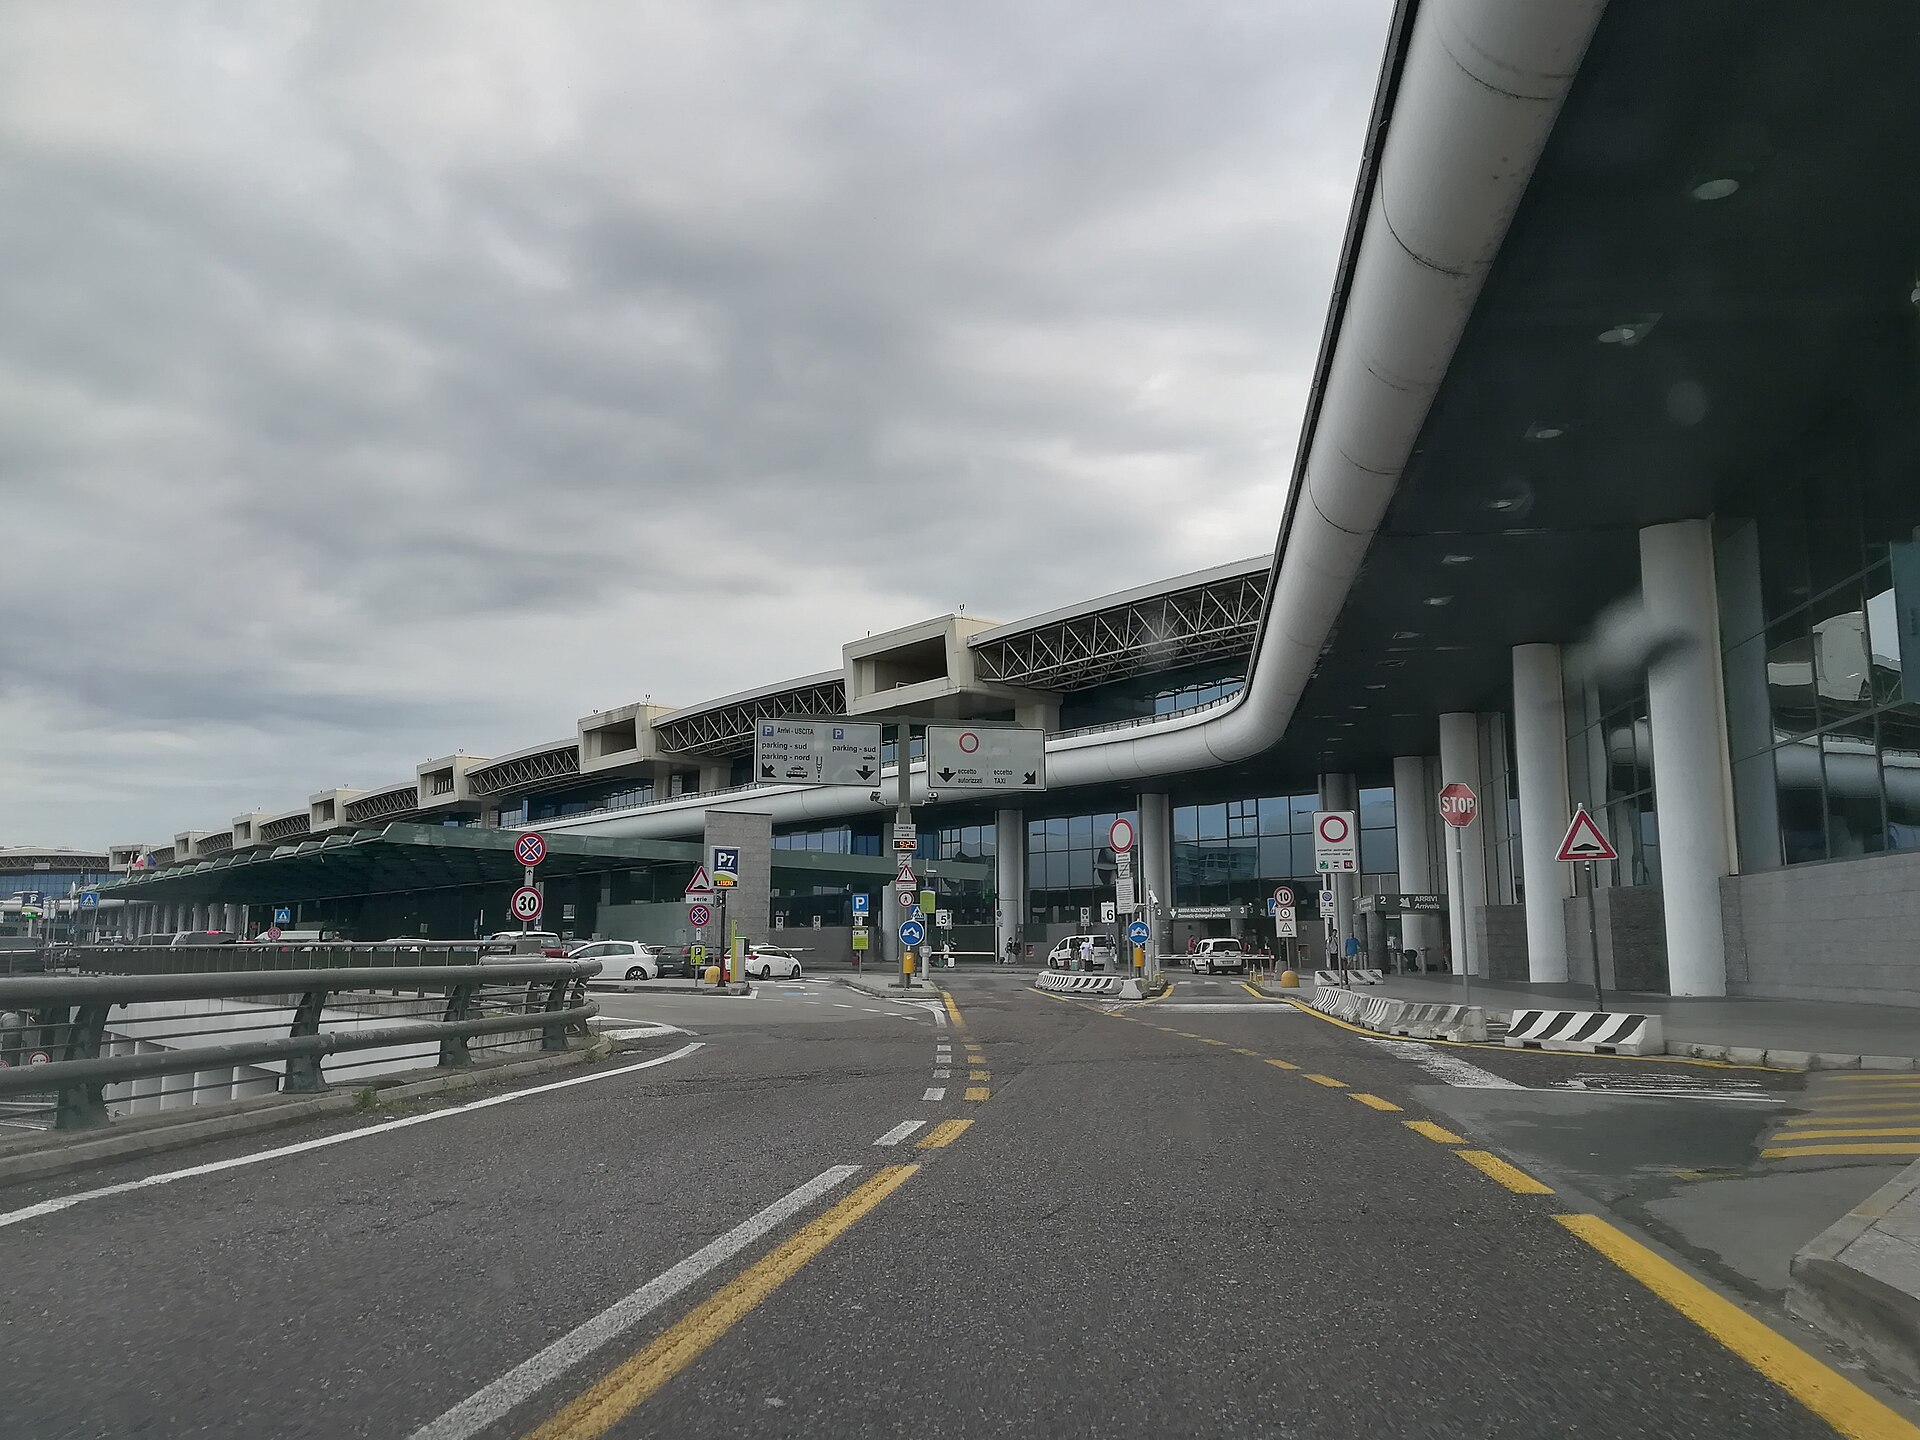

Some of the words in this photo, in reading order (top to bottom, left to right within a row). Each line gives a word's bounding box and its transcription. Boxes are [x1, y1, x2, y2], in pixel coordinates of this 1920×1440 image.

[794, 727, 814, 735] USCITA
[762, 742, 788, 750] parking
[832, 744, 857, 753] parking
[762, 753, 788, 761] parking
[1441, 796, 1475, 814] STOP
[717, 852, 735, 867] P7
[1279, 892, 1289, 902] 10
[1380, 896, 1387, 905] 2
[519, 896, 537, 912] 30
[855, 896, 865, 909] P
[1239, 906, 1245, 914] 3
[1106, 909, 1114, 921] 6
[940, 915, 947, 925] 5
[695, 947, 702, 956] P
